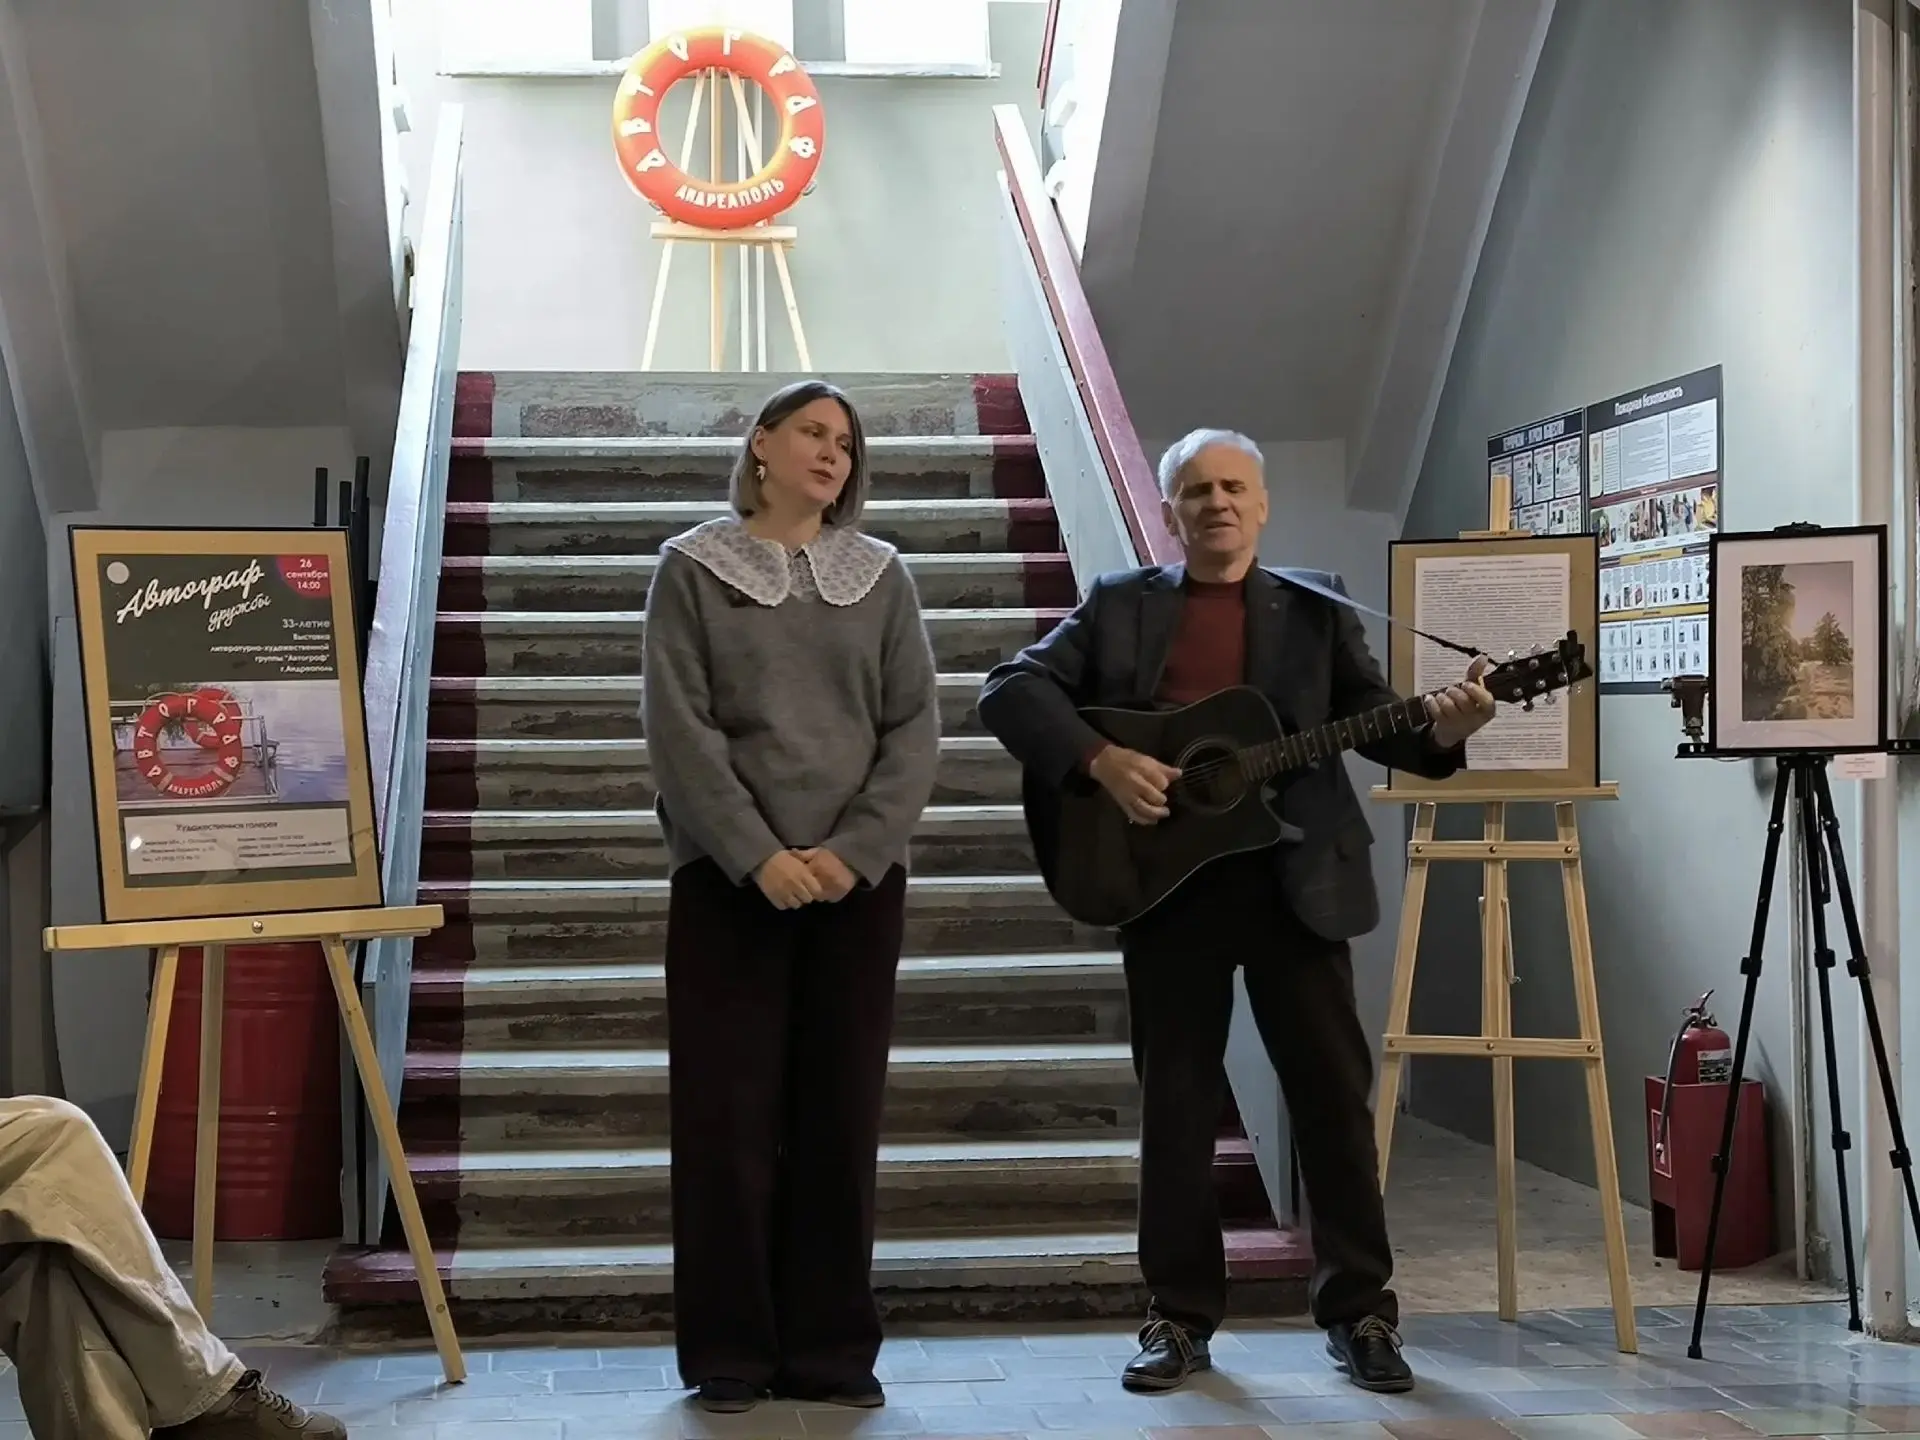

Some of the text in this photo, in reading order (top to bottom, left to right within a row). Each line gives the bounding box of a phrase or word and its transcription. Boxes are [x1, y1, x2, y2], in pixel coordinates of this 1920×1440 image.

[674, 178, 785, 209] АНДРЕАПОЛЬ
[299, 558, 313, 568] 26
[286, 570, 328, 580] сентября
[297, 581, 321, 590] 14:00
[116, 558, 266, 624] Автограф
[207, 593, 272, 633] дружбы
[282, 618, 331, 629] 33-летие
[293, 633, 331, 641] Выставка
[210, 643, 330, 653] литературно-художественной
[255, 655, 284, 664] группы
[137, 698, 238, 778] АВТОГРАФ
[245, 821, 278, 830] галерея
